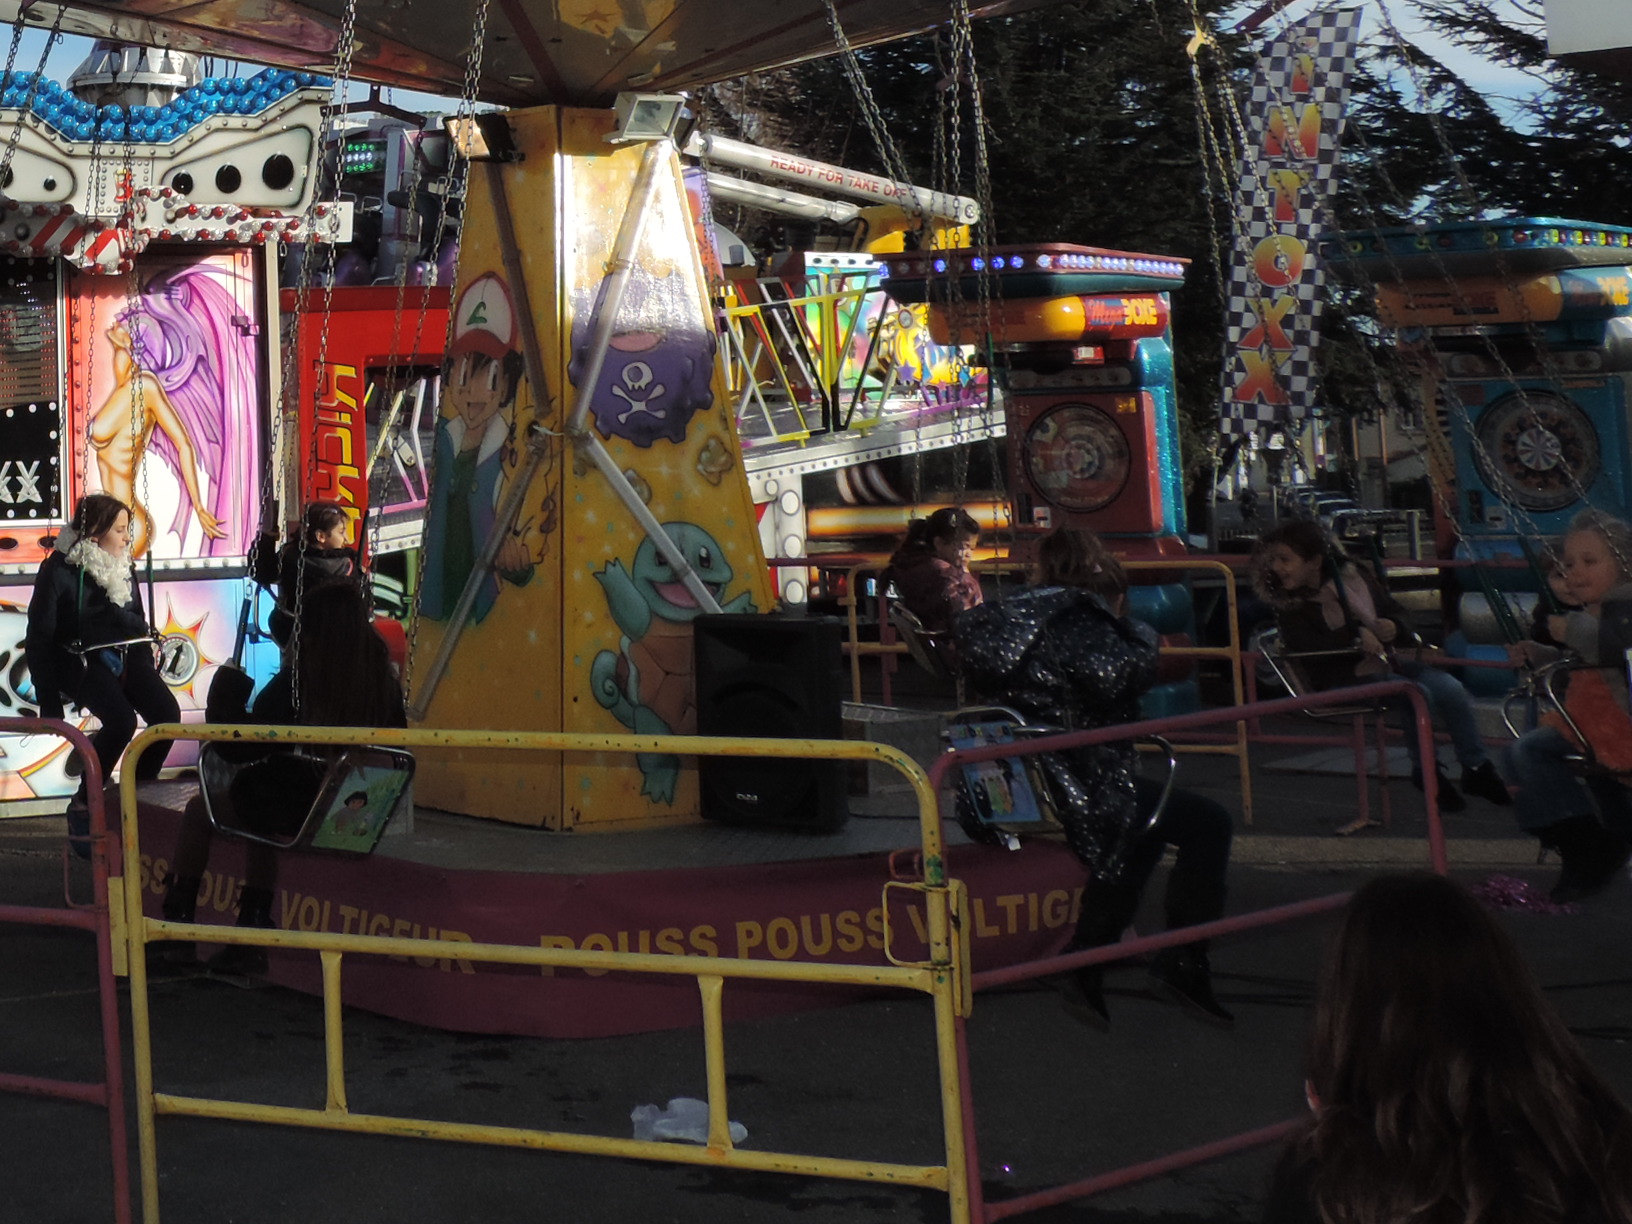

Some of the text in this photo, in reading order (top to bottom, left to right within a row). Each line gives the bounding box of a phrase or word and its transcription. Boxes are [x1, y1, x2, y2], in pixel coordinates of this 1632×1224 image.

[770, 156, 815, 176] READY
[817, 167, 844, 185] FOR
[847, 175, 880, 194] TAKE
[736, 907, 895, 959] POUSS
